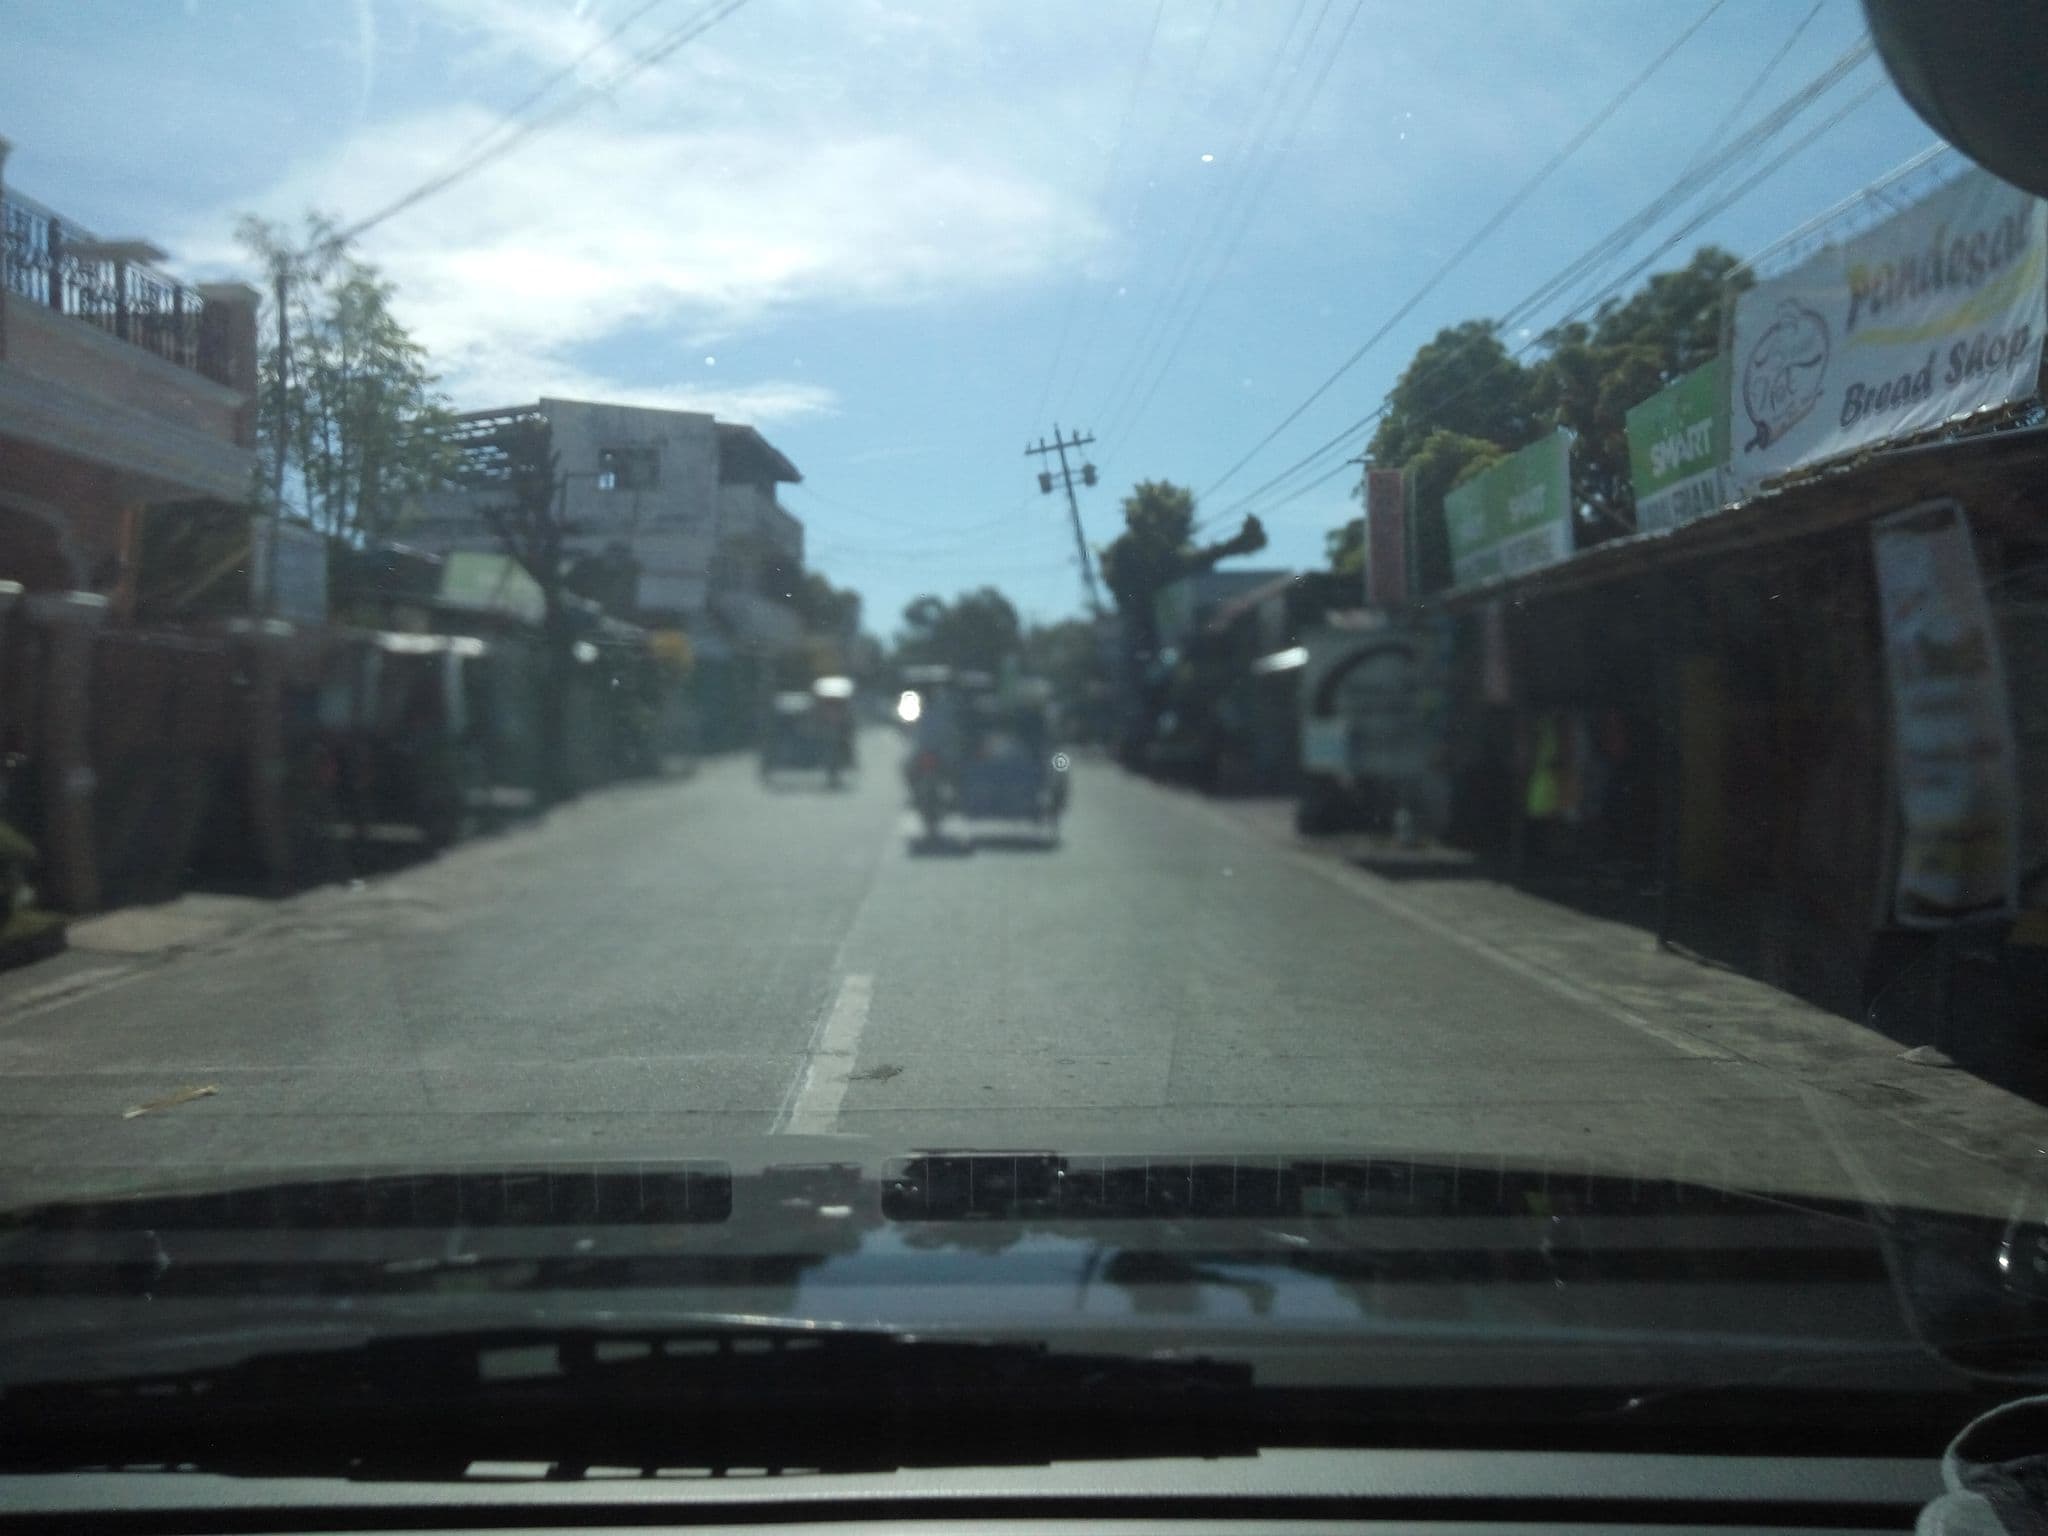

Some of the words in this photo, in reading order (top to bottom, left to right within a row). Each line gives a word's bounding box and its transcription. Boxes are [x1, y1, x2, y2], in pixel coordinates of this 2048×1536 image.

[1839, 347, 1938, 429] Bread
[1943, 320, 2032, 385] Shop
[1649, 417, 1714, 479] SMART
